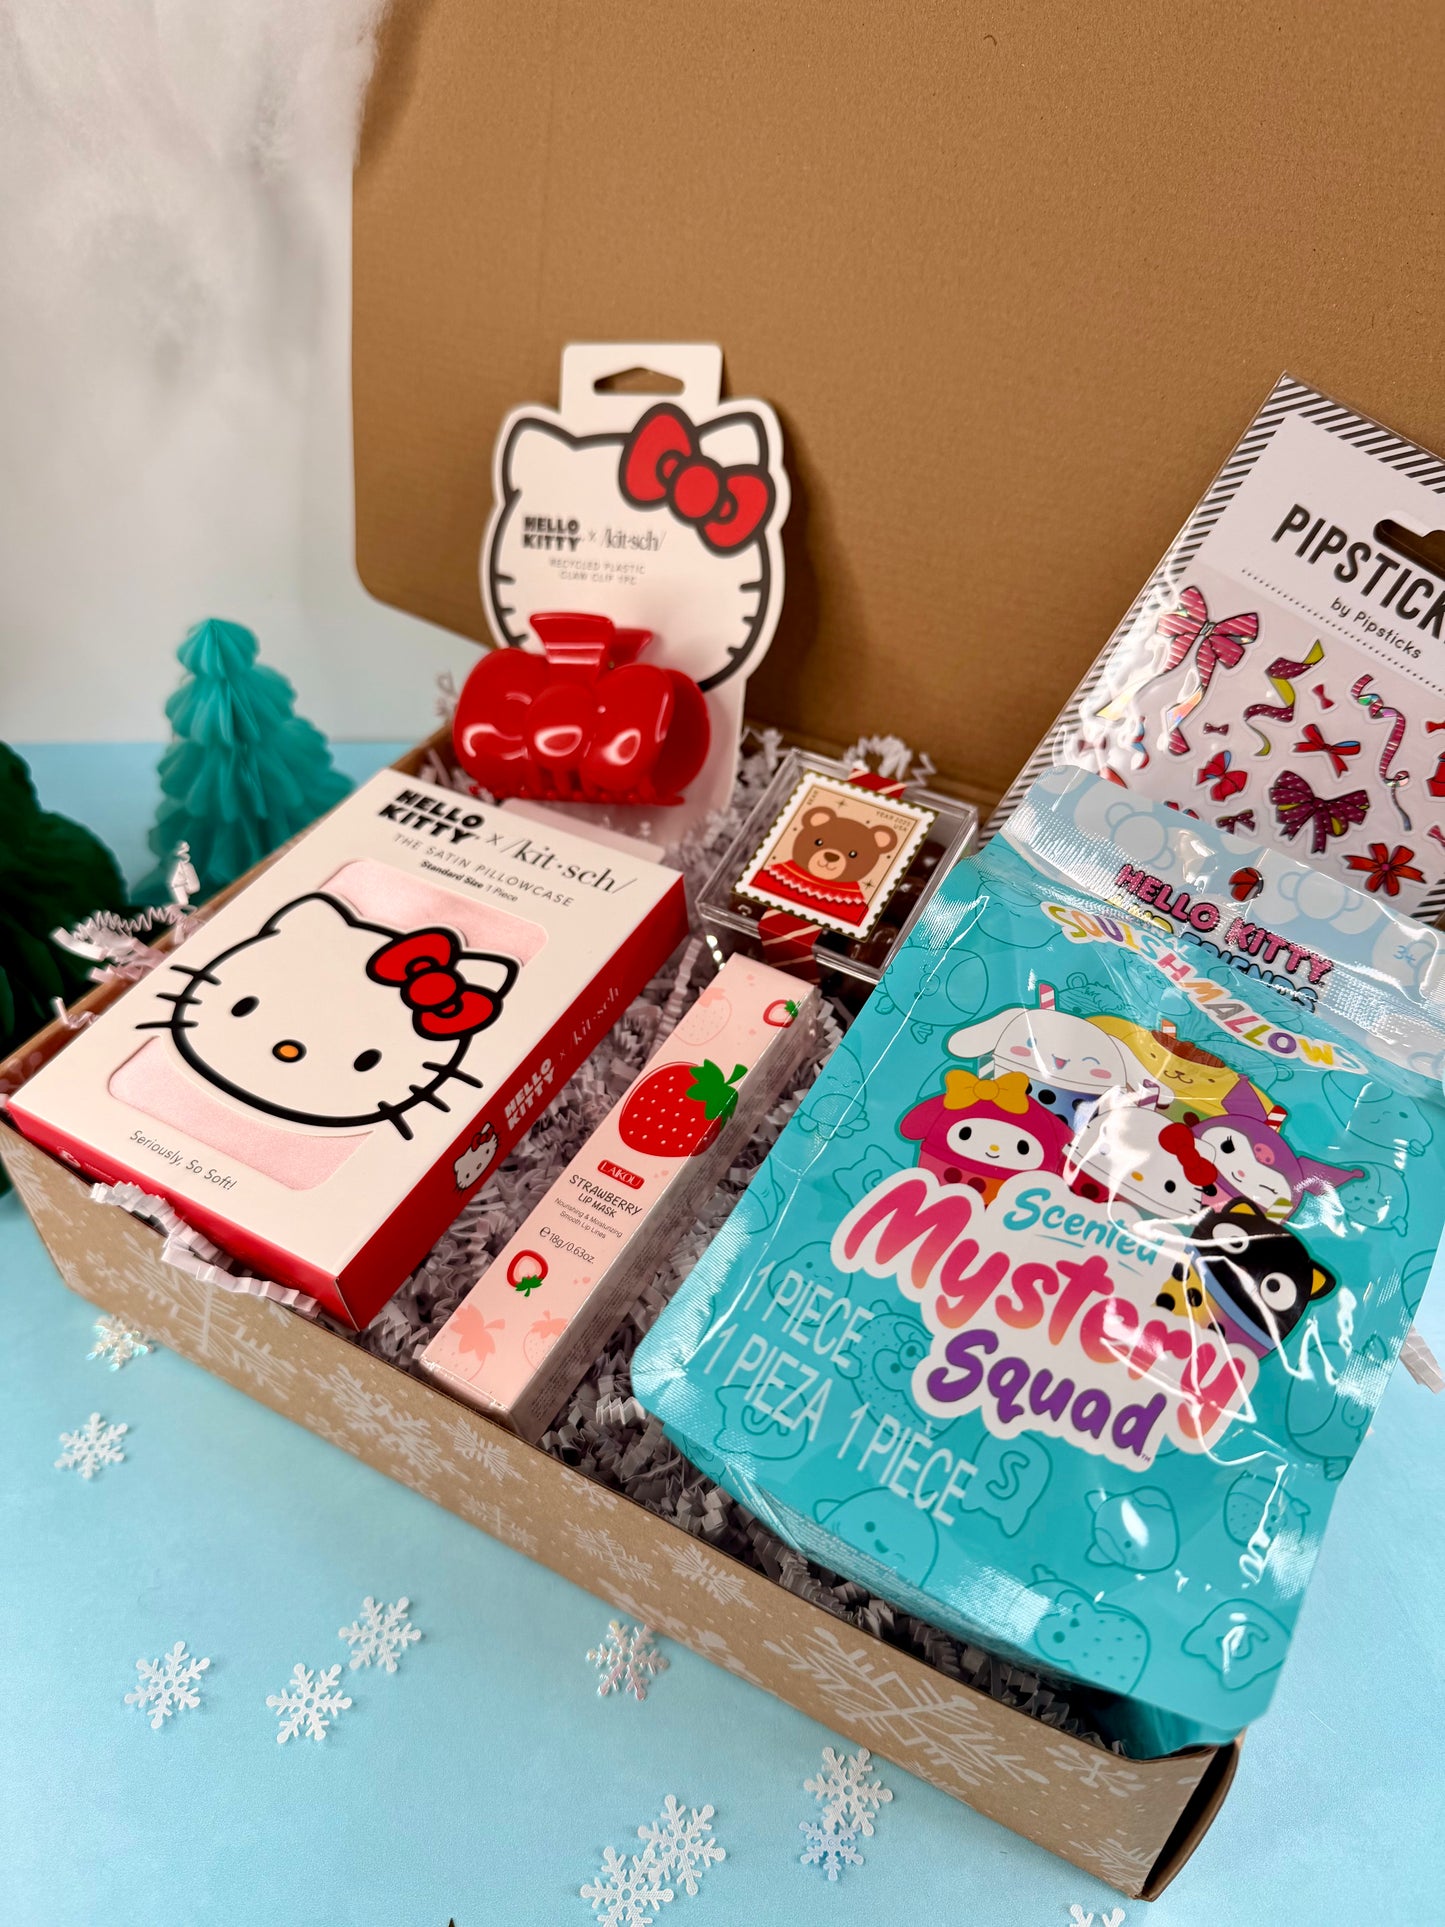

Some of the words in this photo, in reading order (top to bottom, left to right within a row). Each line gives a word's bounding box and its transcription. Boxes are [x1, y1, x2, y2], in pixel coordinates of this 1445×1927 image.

[523, 534, 581, 551] KITTY
[524, 516, 580, 533] HELLO
[549, 557, 601, 570] RECYCLED
[604, 561, 646, 575] PLASTIC
[560, 571, 588, 581] CLAW
[592, 573, 614, 584] CLIP
[1271, 503, 1445, 643] PIPSTICK
[1329, 597, 1351, 618] by
[1353, 611, 1422, 659] Pipsticks
[377, 803, 476, 845] KITTY
[393, 789, 485, 829] HELLO
[393, 833, 423, 850] THE
[426, 845, 472, 869] SATIN
[475, 864, 575, 908] PILLOWCASE
[420, 860, 464, 882] Standard
[463, 875, 485, 889] Size
[493, 886, 519, 903] Piece
[1115, 864, 1220, 932] HELLO
[1224, 916, 1334, 985] KITTY
[1047, 904, 1360, 1070] SQUISHMALLOWS
[504, 1058, 552, 1119] HELLO
[507, 1067, 556, 1131] KITTY
[130, 1130, 182, 1167] Seriously,
[185, 1159, 203, 1174] So
[204, 1168, 238, 1190] Soft!
[600, 1160, 642, 1187] LAIKOU
[569, 1174, 643, 1216] STRAWBERRY
[578, 1193, 592, 1205] LIP
[592, 1201, 617, 1218] MASK
[554, 1197, 585, 1218] Nourishing
[590, 1216, 623, 1238] Moisturizing
[560, 1210, 580, 1226] Smooth
[581, 1220, 591, 1231] Lip
[591, 1226, 607, 1239] Lines
[1003, 1187, 1166, 1266] Scented
[549, 1231, 595, 1264] 18g/0.63oz.
[743, 1260, 776, 1311] 1
[762, 1269, 875, 1369] PIECE
[843, 1179, 1247, 1440] Mystery
[704, 1323, 738, 1375] 1
[723, 1334, 833, 1442] PIEZA
[837, 1402, 870, 1459] 1
[857, 1414, 978, 1526] PIÈCE
